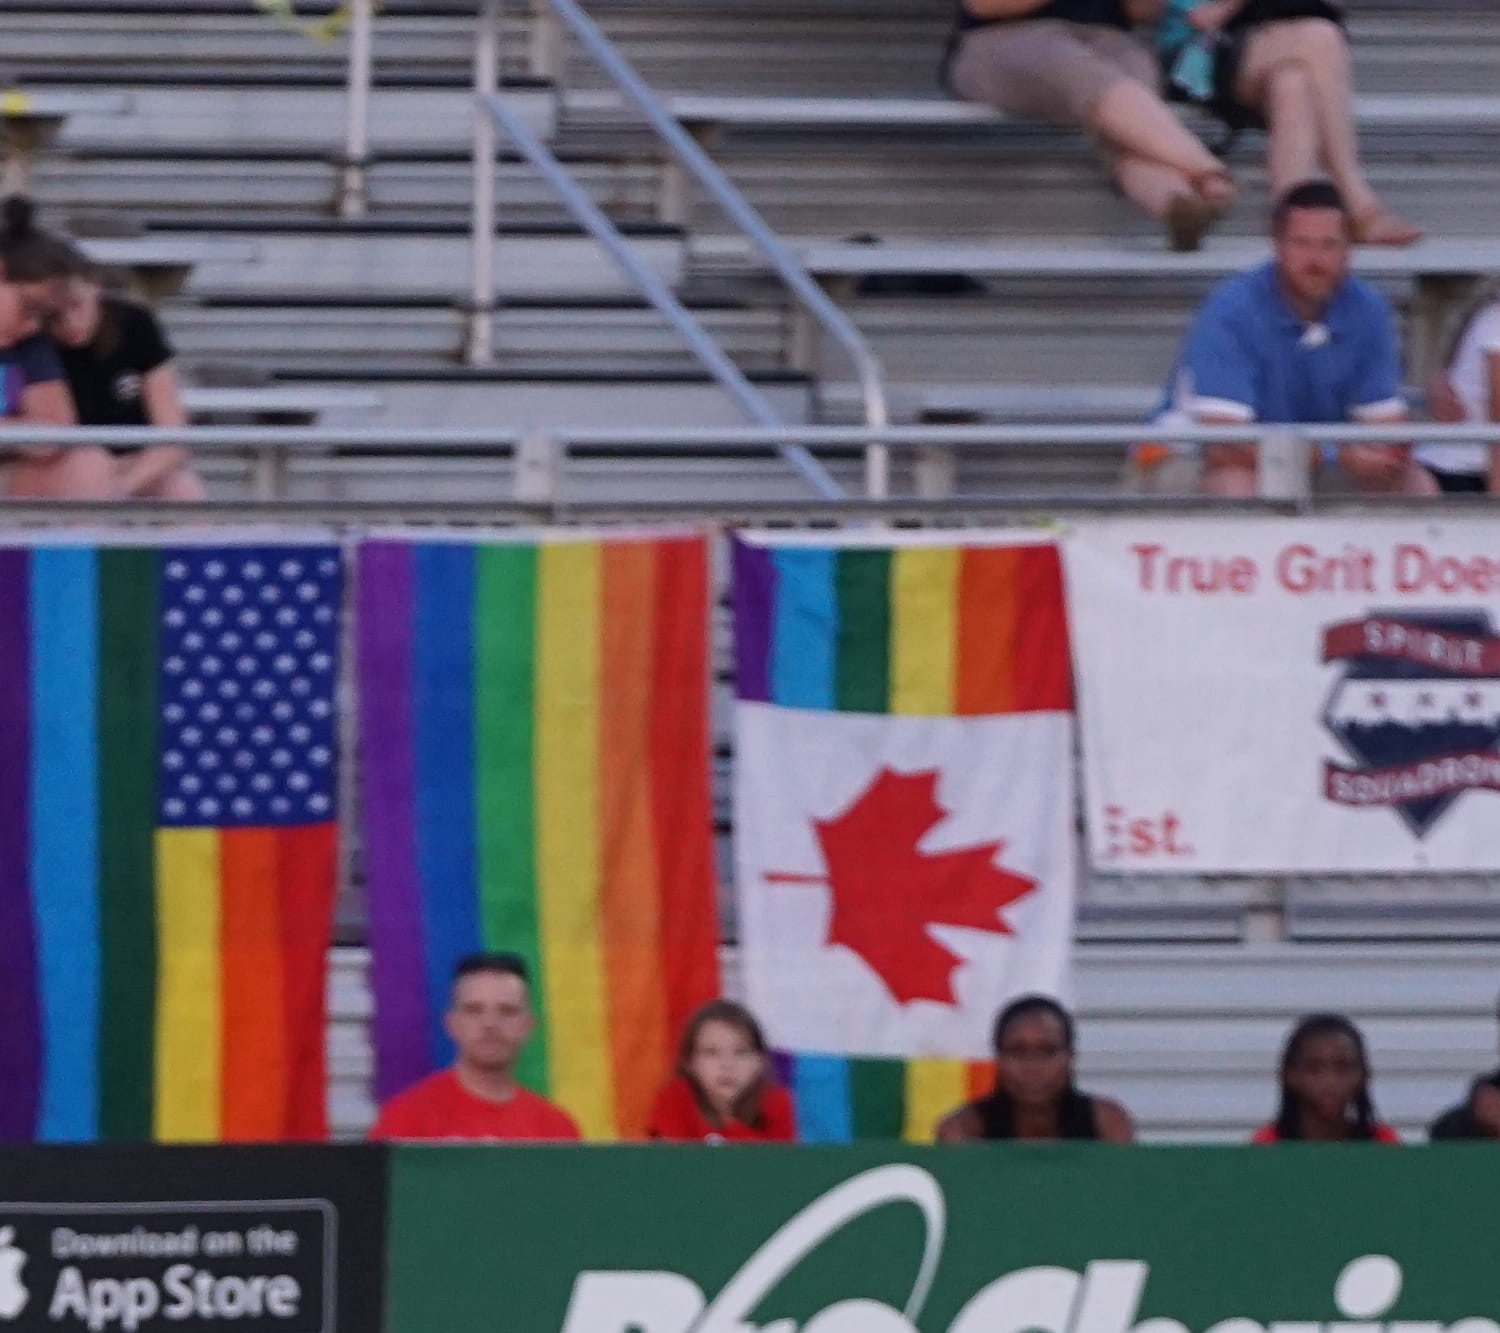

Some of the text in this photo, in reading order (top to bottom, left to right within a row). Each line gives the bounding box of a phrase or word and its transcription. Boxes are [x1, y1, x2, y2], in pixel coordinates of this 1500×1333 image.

[1131, 544, 1256, 593] True
[1275, 544, 1375, 593] Grit
[50, 1226, 298, 1258] Download on the
[48, 1262, 300, 1333] App Store
